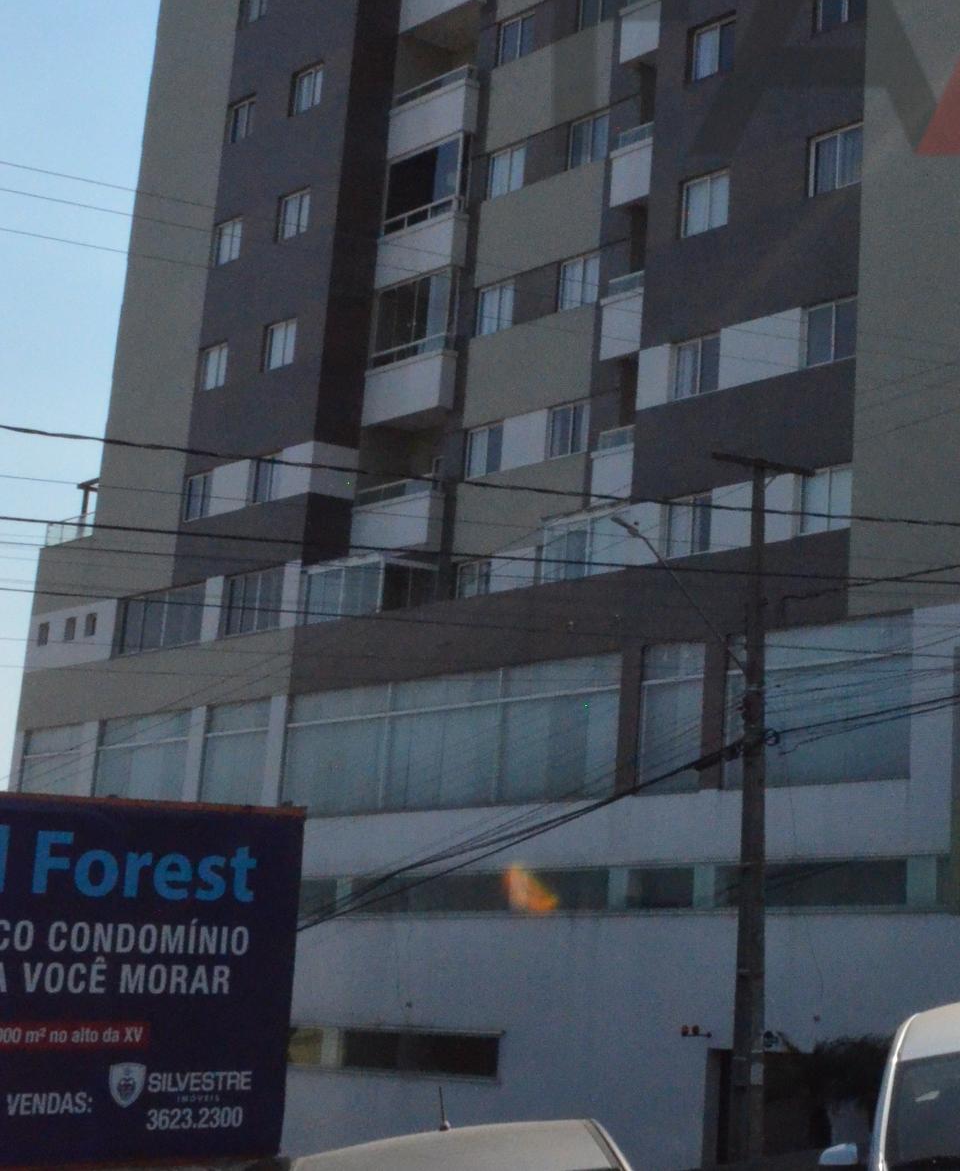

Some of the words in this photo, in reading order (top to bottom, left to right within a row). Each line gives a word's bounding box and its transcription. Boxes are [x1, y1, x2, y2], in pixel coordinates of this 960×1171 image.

[31, 830, 258, 903] Forest
[48, 918, 250, 956] CONDOMÍNIO
[23, 956, 107, 994] VOCÊ
[119, 964, 231, 995] MORAR
[49, 1030, 67, 1043] no
[71, 1028, 99, 1043] alto
[102, 1027, 120, 1043] da
[123, 1026, 144, 1043] XV
[148, 1071, 253, 1093] SILVESTRE
[6, 1093, 94, 1116] VENDAS:
[146, 1106, 244, 1131] 3623.2300
